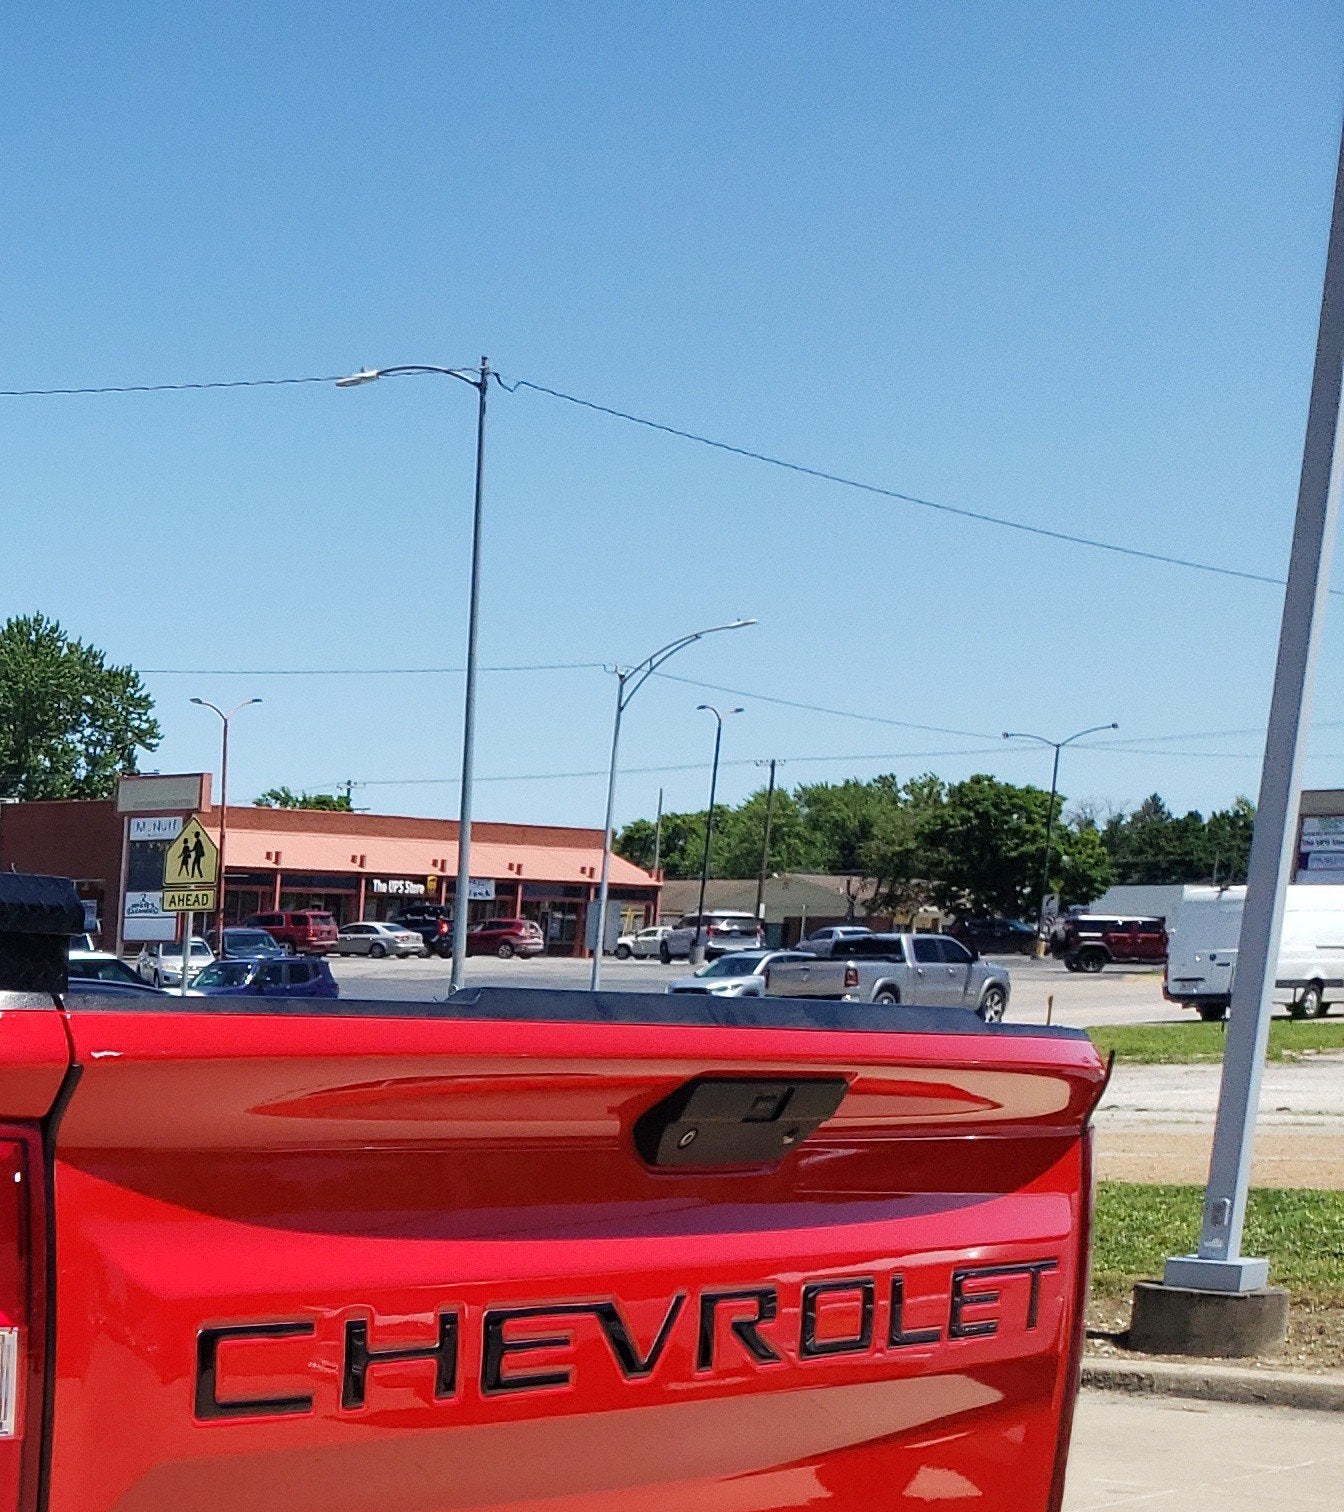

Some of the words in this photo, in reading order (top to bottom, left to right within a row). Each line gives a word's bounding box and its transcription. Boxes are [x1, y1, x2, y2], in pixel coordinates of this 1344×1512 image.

[373, 879, 388, 893] The
[389, 880, 404, 894] UPS
[405, 880, 425, 895] Store
[169, 894, 209, 907] AHEAD
[195, 1258, 1059, 1423] CHEVROLET
